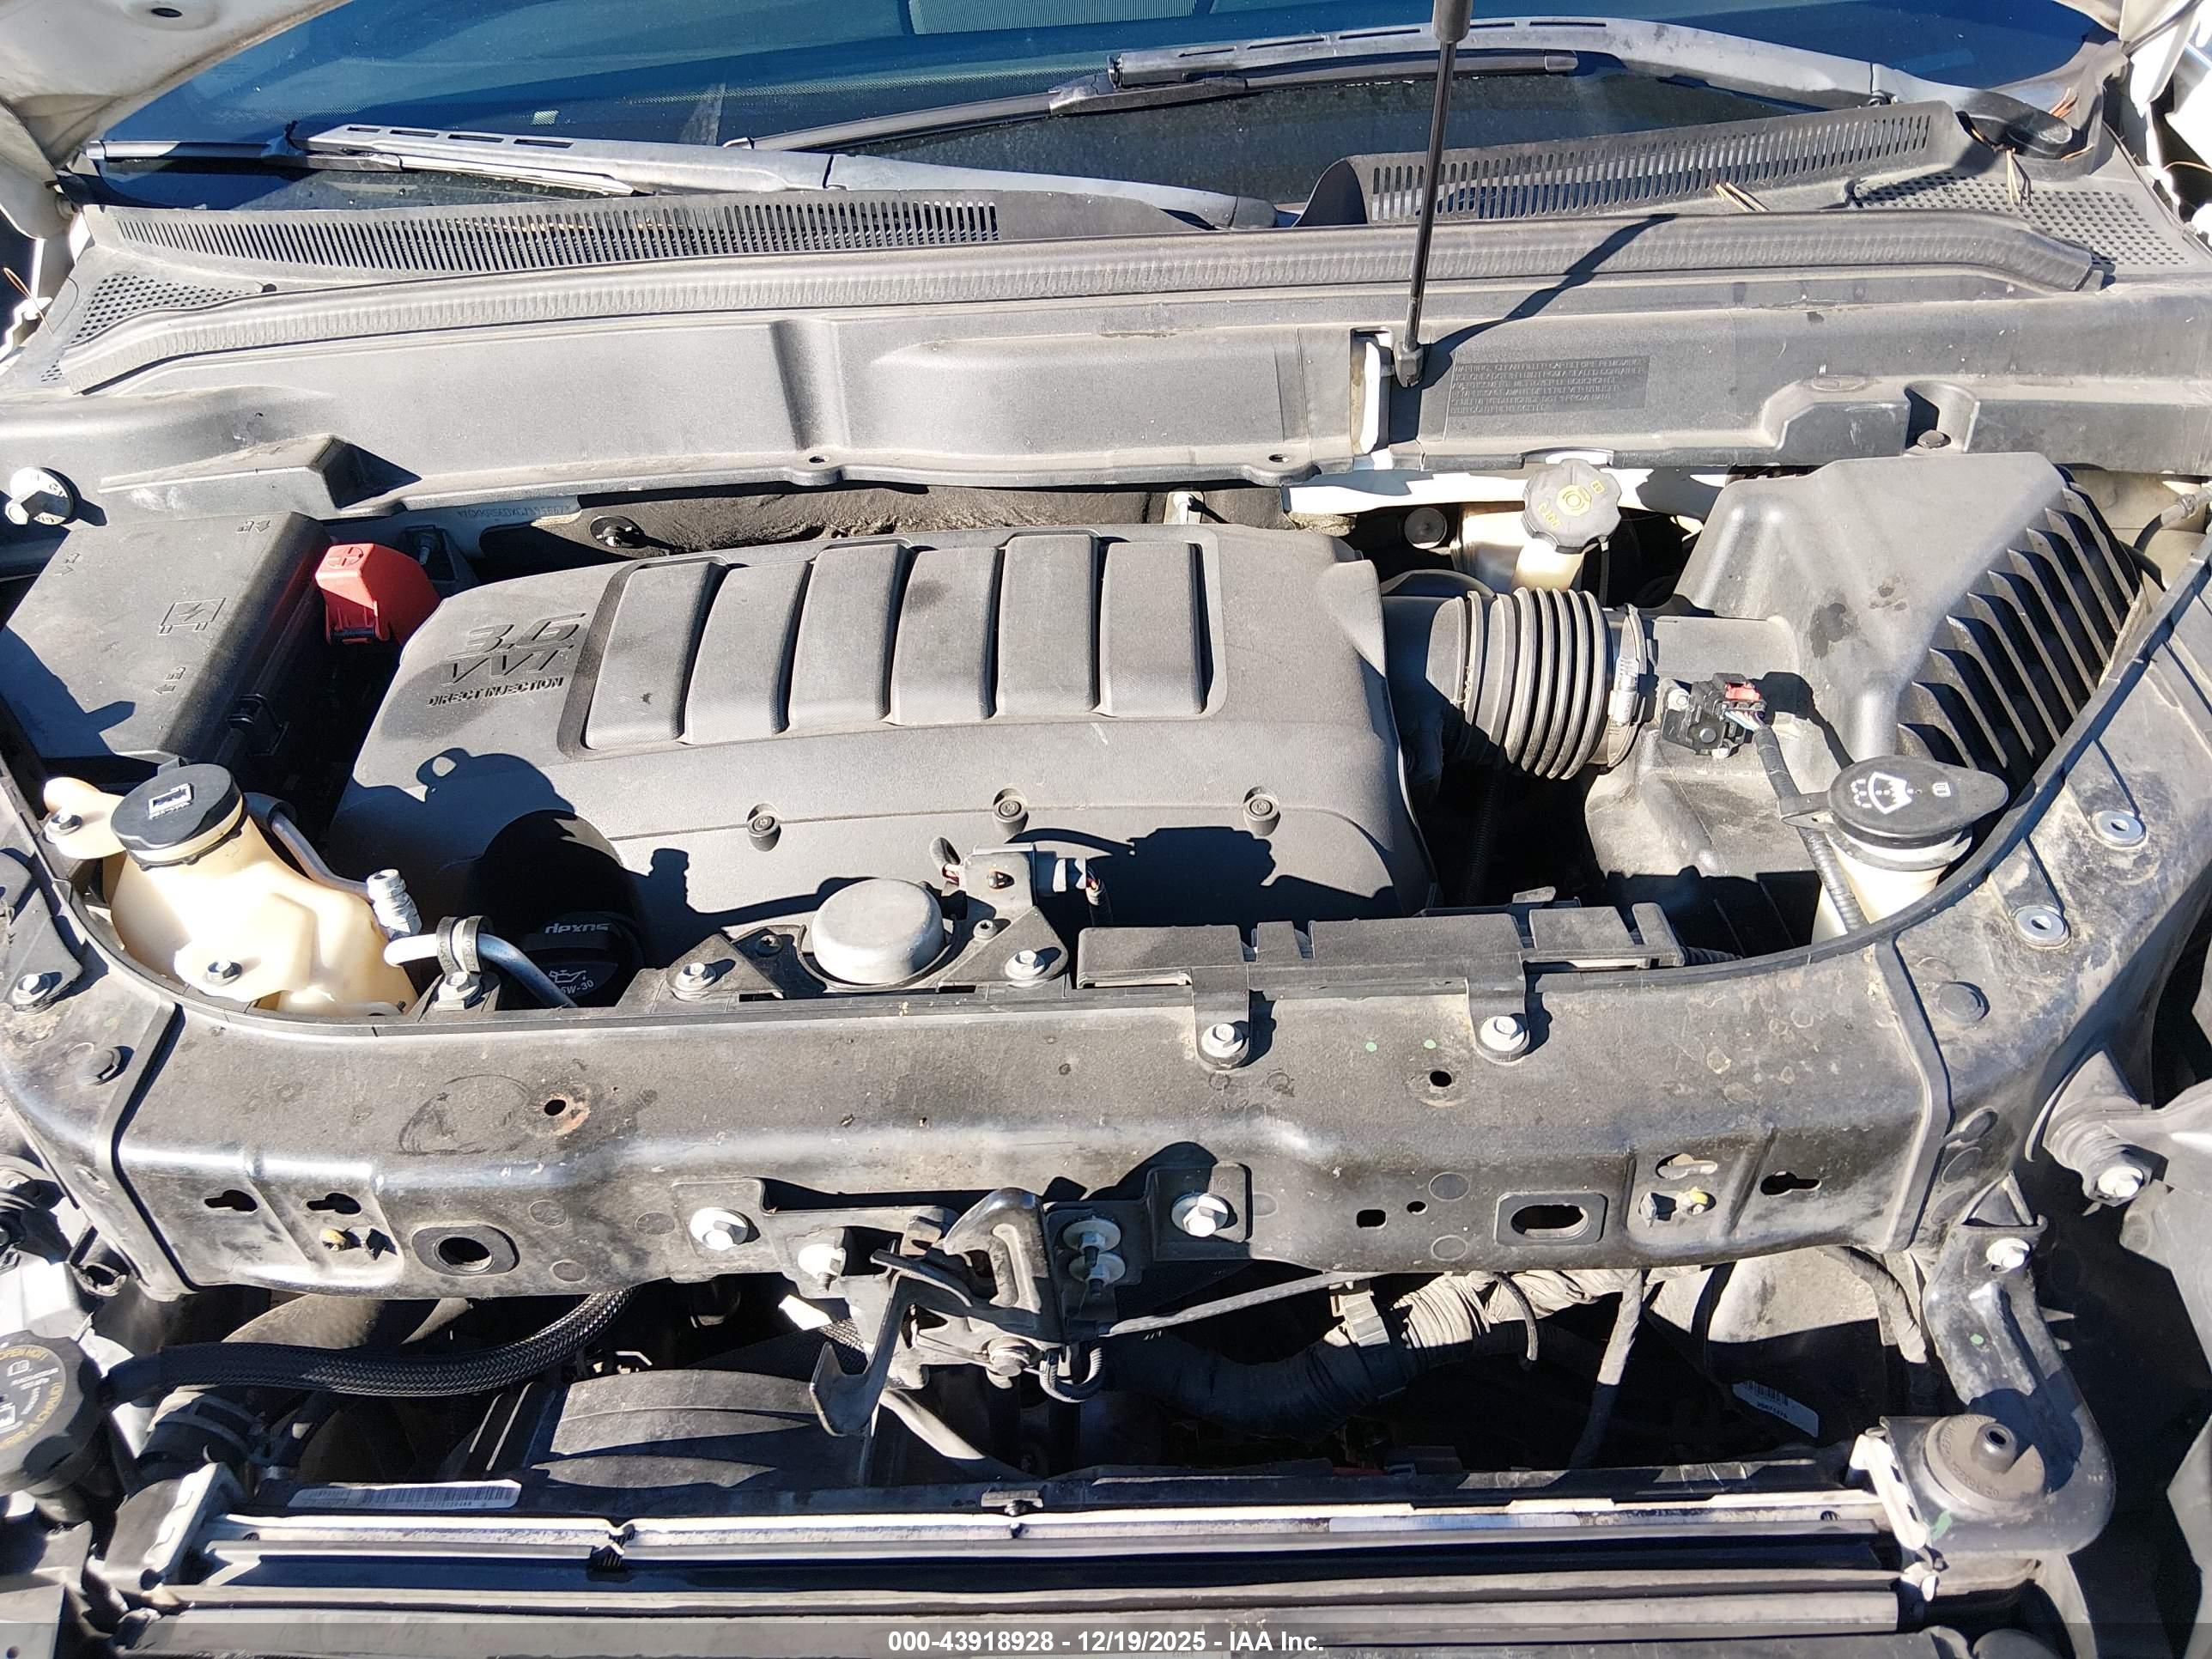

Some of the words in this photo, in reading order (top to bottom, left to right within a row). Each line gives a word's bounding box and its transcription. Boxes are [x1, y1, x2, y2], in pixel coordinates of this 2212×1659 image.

[446, 612, 587, 659] 3.6
[441, 645, 575, 687] VVT
[426, 689, 485, 708] DIRECT
[483, 677, 565, 698] INJECTION
